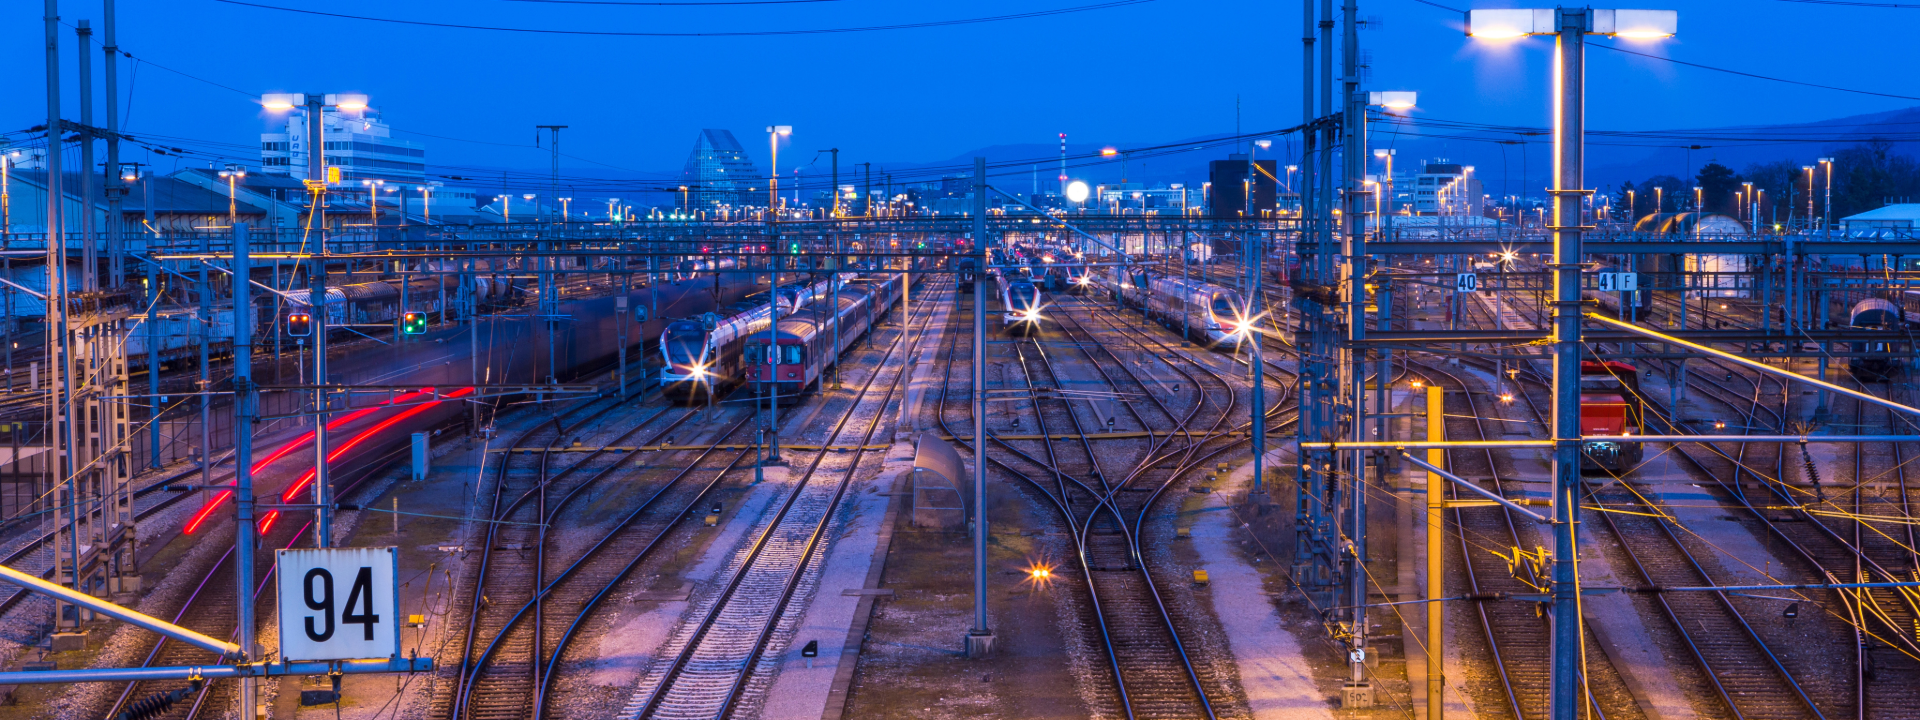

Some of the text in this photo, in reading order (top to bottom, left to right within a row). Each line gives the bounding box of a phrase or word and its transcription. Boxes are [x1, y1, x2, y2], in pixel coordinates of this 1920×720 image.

[1459, 275, 1475, 290] 40
[1600, 274, 1630, 289] 41 F
[303, 567, 379, 642] 94
